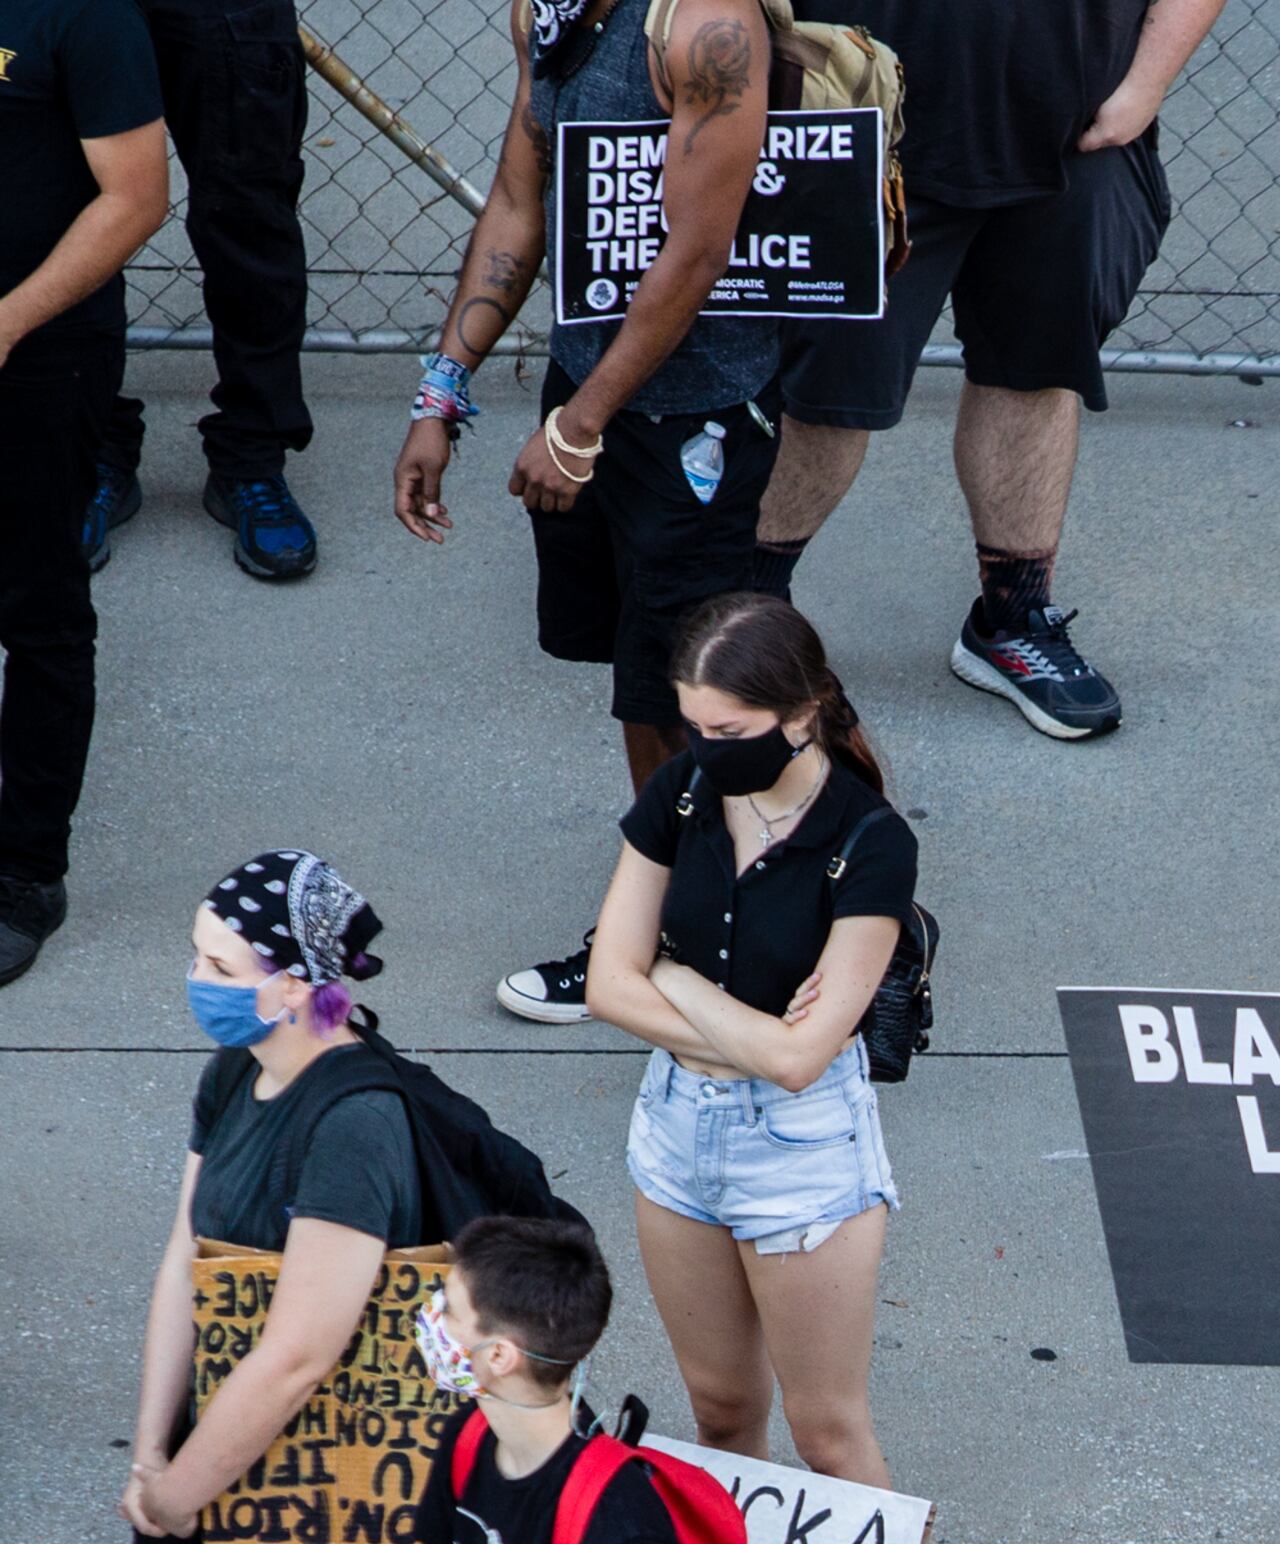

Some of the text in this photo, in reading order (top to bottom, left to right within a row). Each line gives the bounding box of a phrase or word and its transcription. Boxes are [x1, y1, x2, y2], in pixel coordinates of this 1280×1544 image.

[588, 125, 853, 169] DEMRIZE
[588, 163, 786, 204] DIS &
[586, 235, 811, 272] THE LICE
[708, 291, 740, 300] ERICA
[713, 279, 765, 290] MOCRATIC
